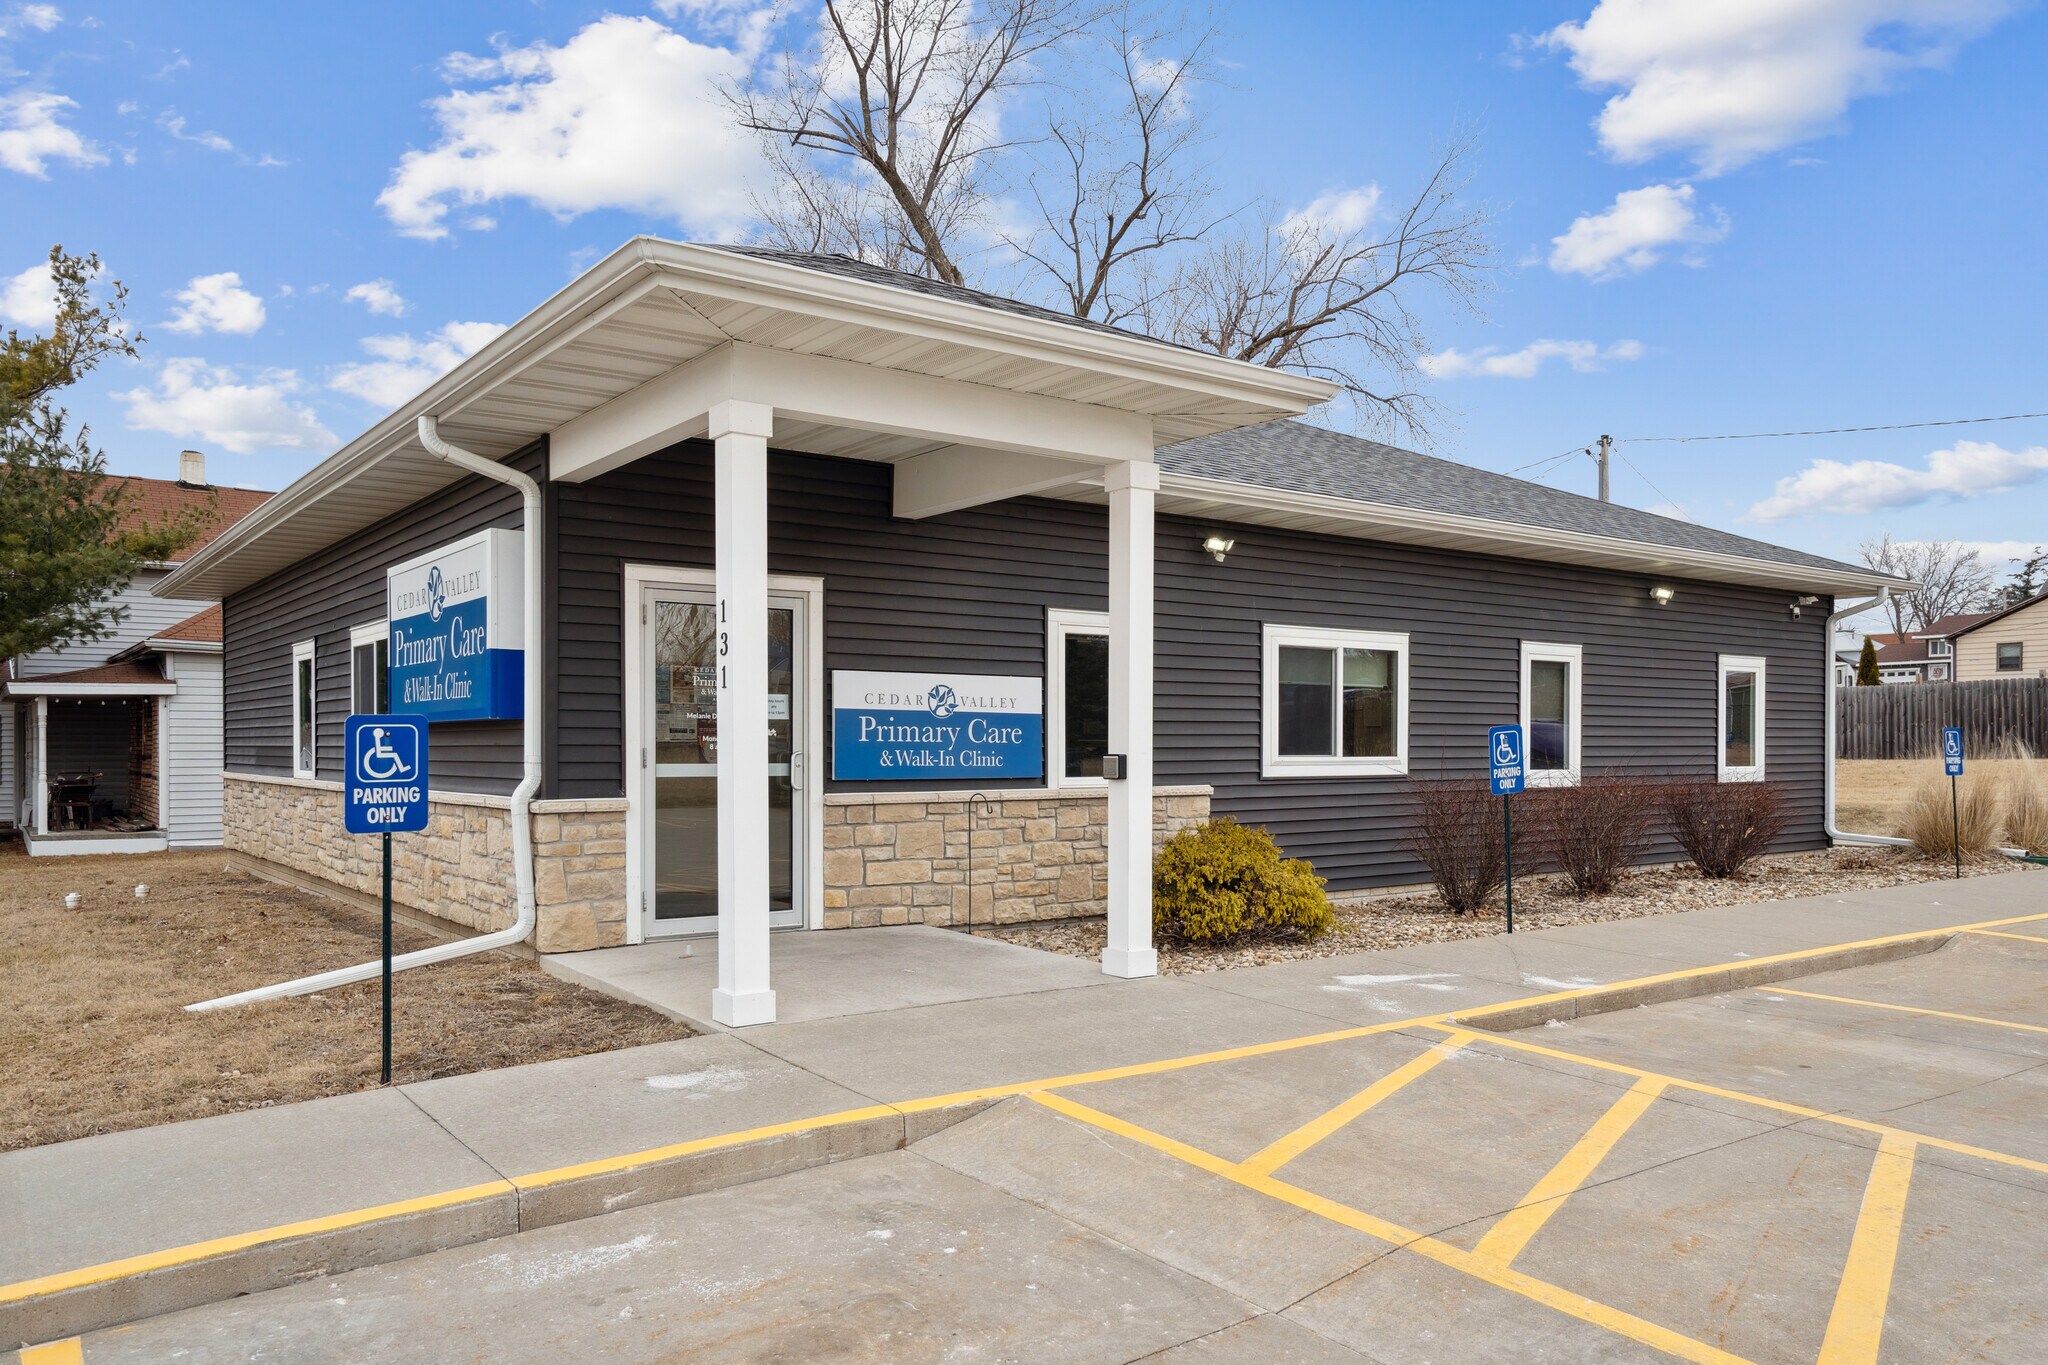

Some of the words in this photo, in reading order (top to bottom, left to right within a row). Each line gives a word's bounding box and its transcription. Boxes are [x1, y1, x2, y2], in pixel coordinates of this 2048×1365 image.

[397, 588, 427, 612] CEDAR
[445, 570, 481, 597] VALLEY
[394, 627, 448, 674] Primary
[450, 616, 485, 659] Care
[445, 670, 473, 700] Clinic
[692, 675, 718, 687] Prim
[864, 692, 924, 706] CEDAR
[960, 695, 1018, 709] VALLEY
[858, 715, 961, 751] Primary
[967, 718, 1023, 744] Care
[959, 750, 1004, 767] Clinic
[1493, 766, 1521, 779] PARKING
[1499, 778, 1516, 790] ONLY
[353, 786, 421, 805] PARKING
[366, 806, 408, 824] ONLY
